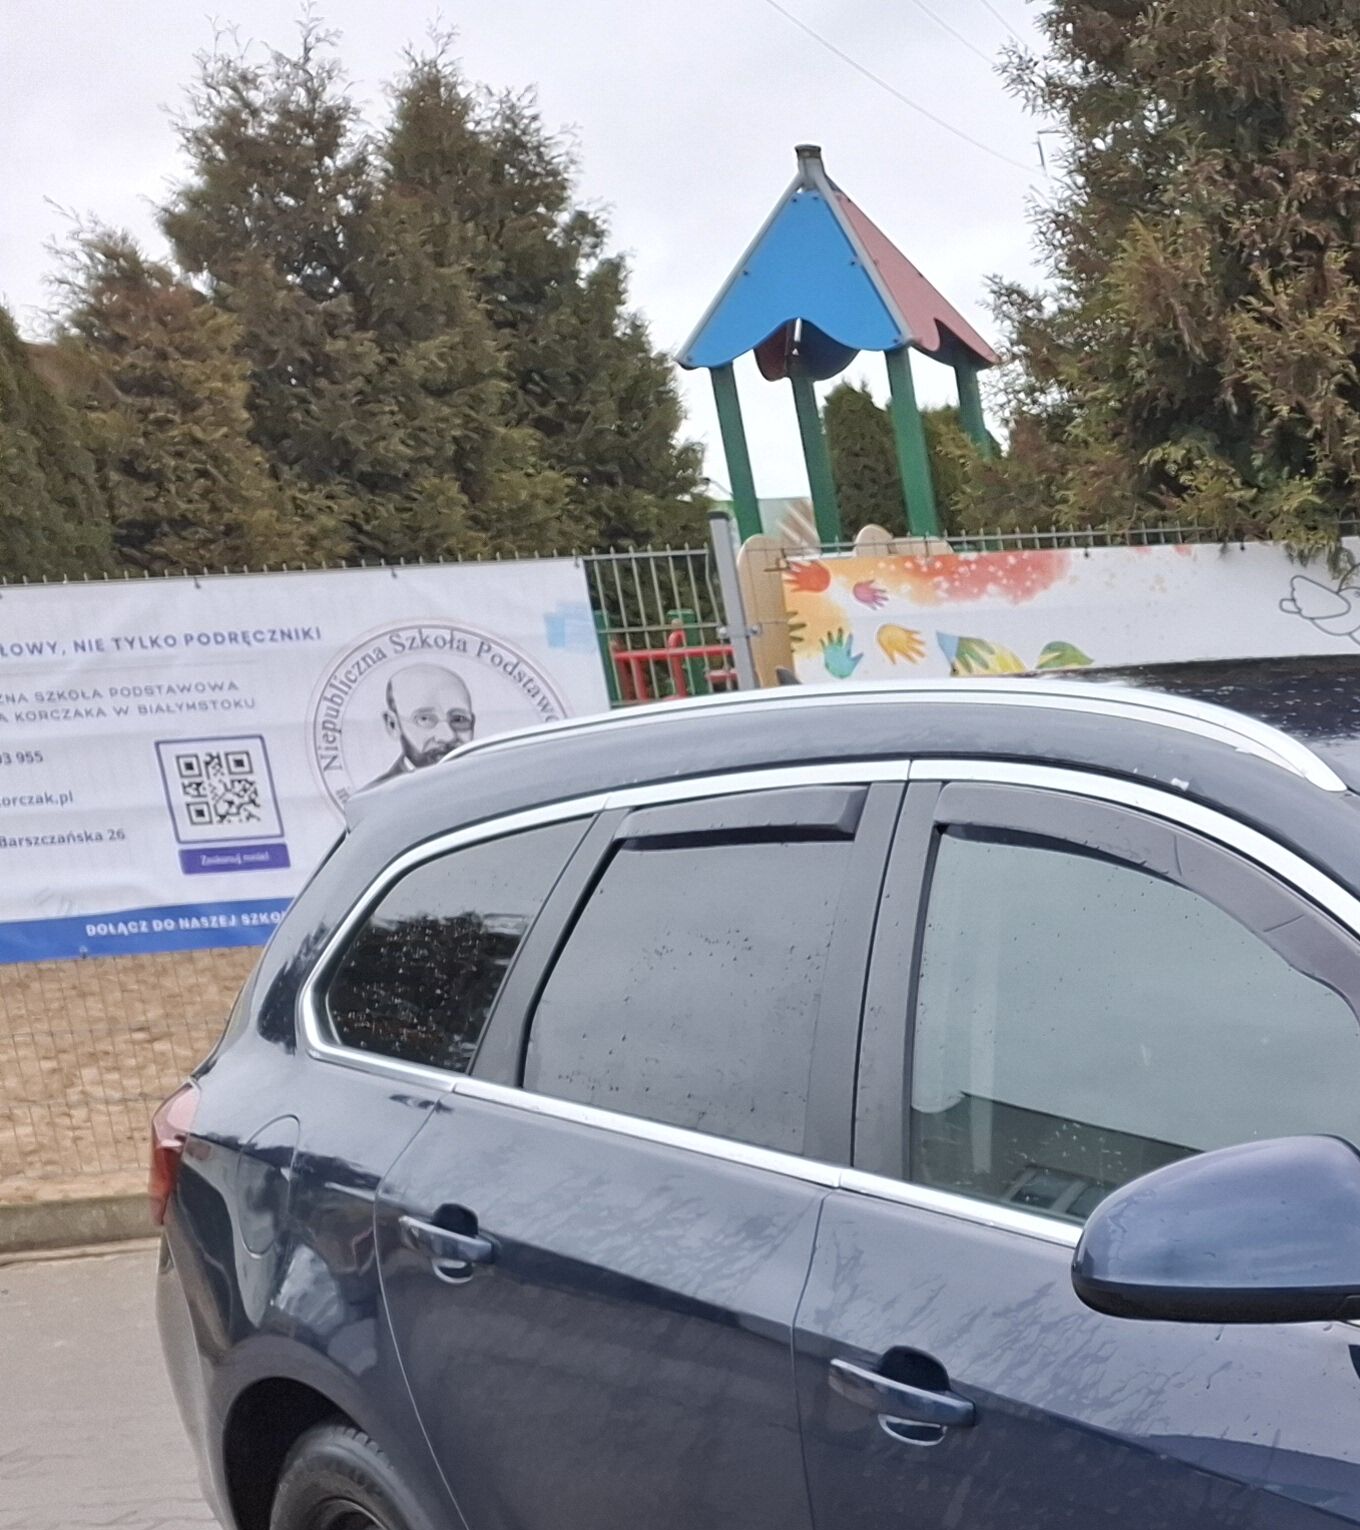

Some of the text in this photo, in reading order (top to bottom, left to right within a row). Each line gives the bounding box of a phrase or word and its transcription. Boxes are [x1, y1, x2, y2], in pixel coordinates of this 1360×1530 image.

[73, 638, 105, 653] NIE
[111, 633, 177, 651] TYLKO
[184, 626, 322, 648] PODRĘCZNIKI
[34, 687, 103, 703] SZKOŁA
[109, 679, 239, 698] PODSTAWOWA
[320, 645, 388, 772] Niepubliczna
[389, 628, 468, 655] Szkoła
[14, 706, 107, 722] KORCZAKA
[112, 704, 130, 717] W
[138, 696, 256, 715] BIAŁYMSTOKU
[0, 749, 43, 766] 3 955
[0, 789, 73, 808] orczak.pl
[107, 827, 126, 842] 26
[86, 919, 149, 937] DOŁĄCZ
[152, 918, 175, 932] DO
[179, 914, 237, 930] NASZEJ
